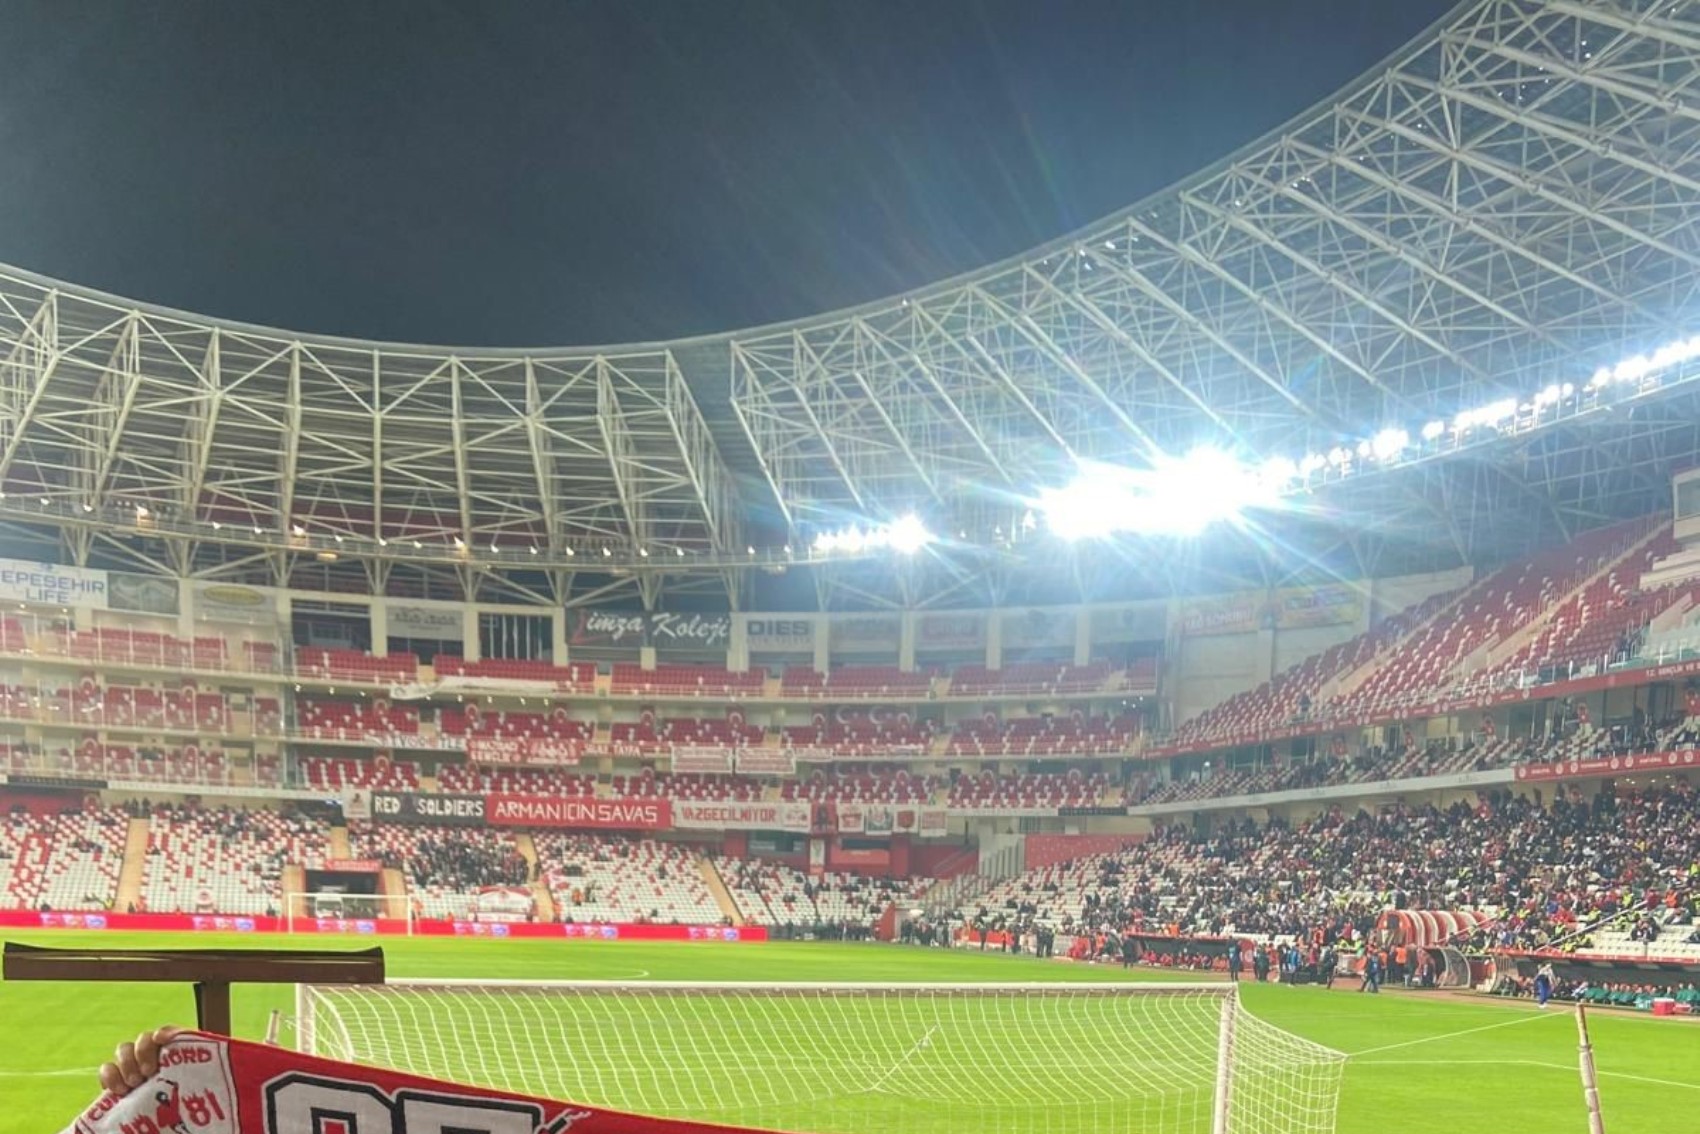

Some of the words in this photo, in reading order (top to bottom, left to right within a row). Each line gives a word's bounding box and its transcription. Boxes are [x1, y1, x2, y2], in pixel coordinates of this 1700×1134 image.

[651, 611, 732, 644] Koleji
[747, 620, 809, 635] DIES
[374, 796, 402, 813] RED
[416, 798, 484, 817] SOLDIERS
